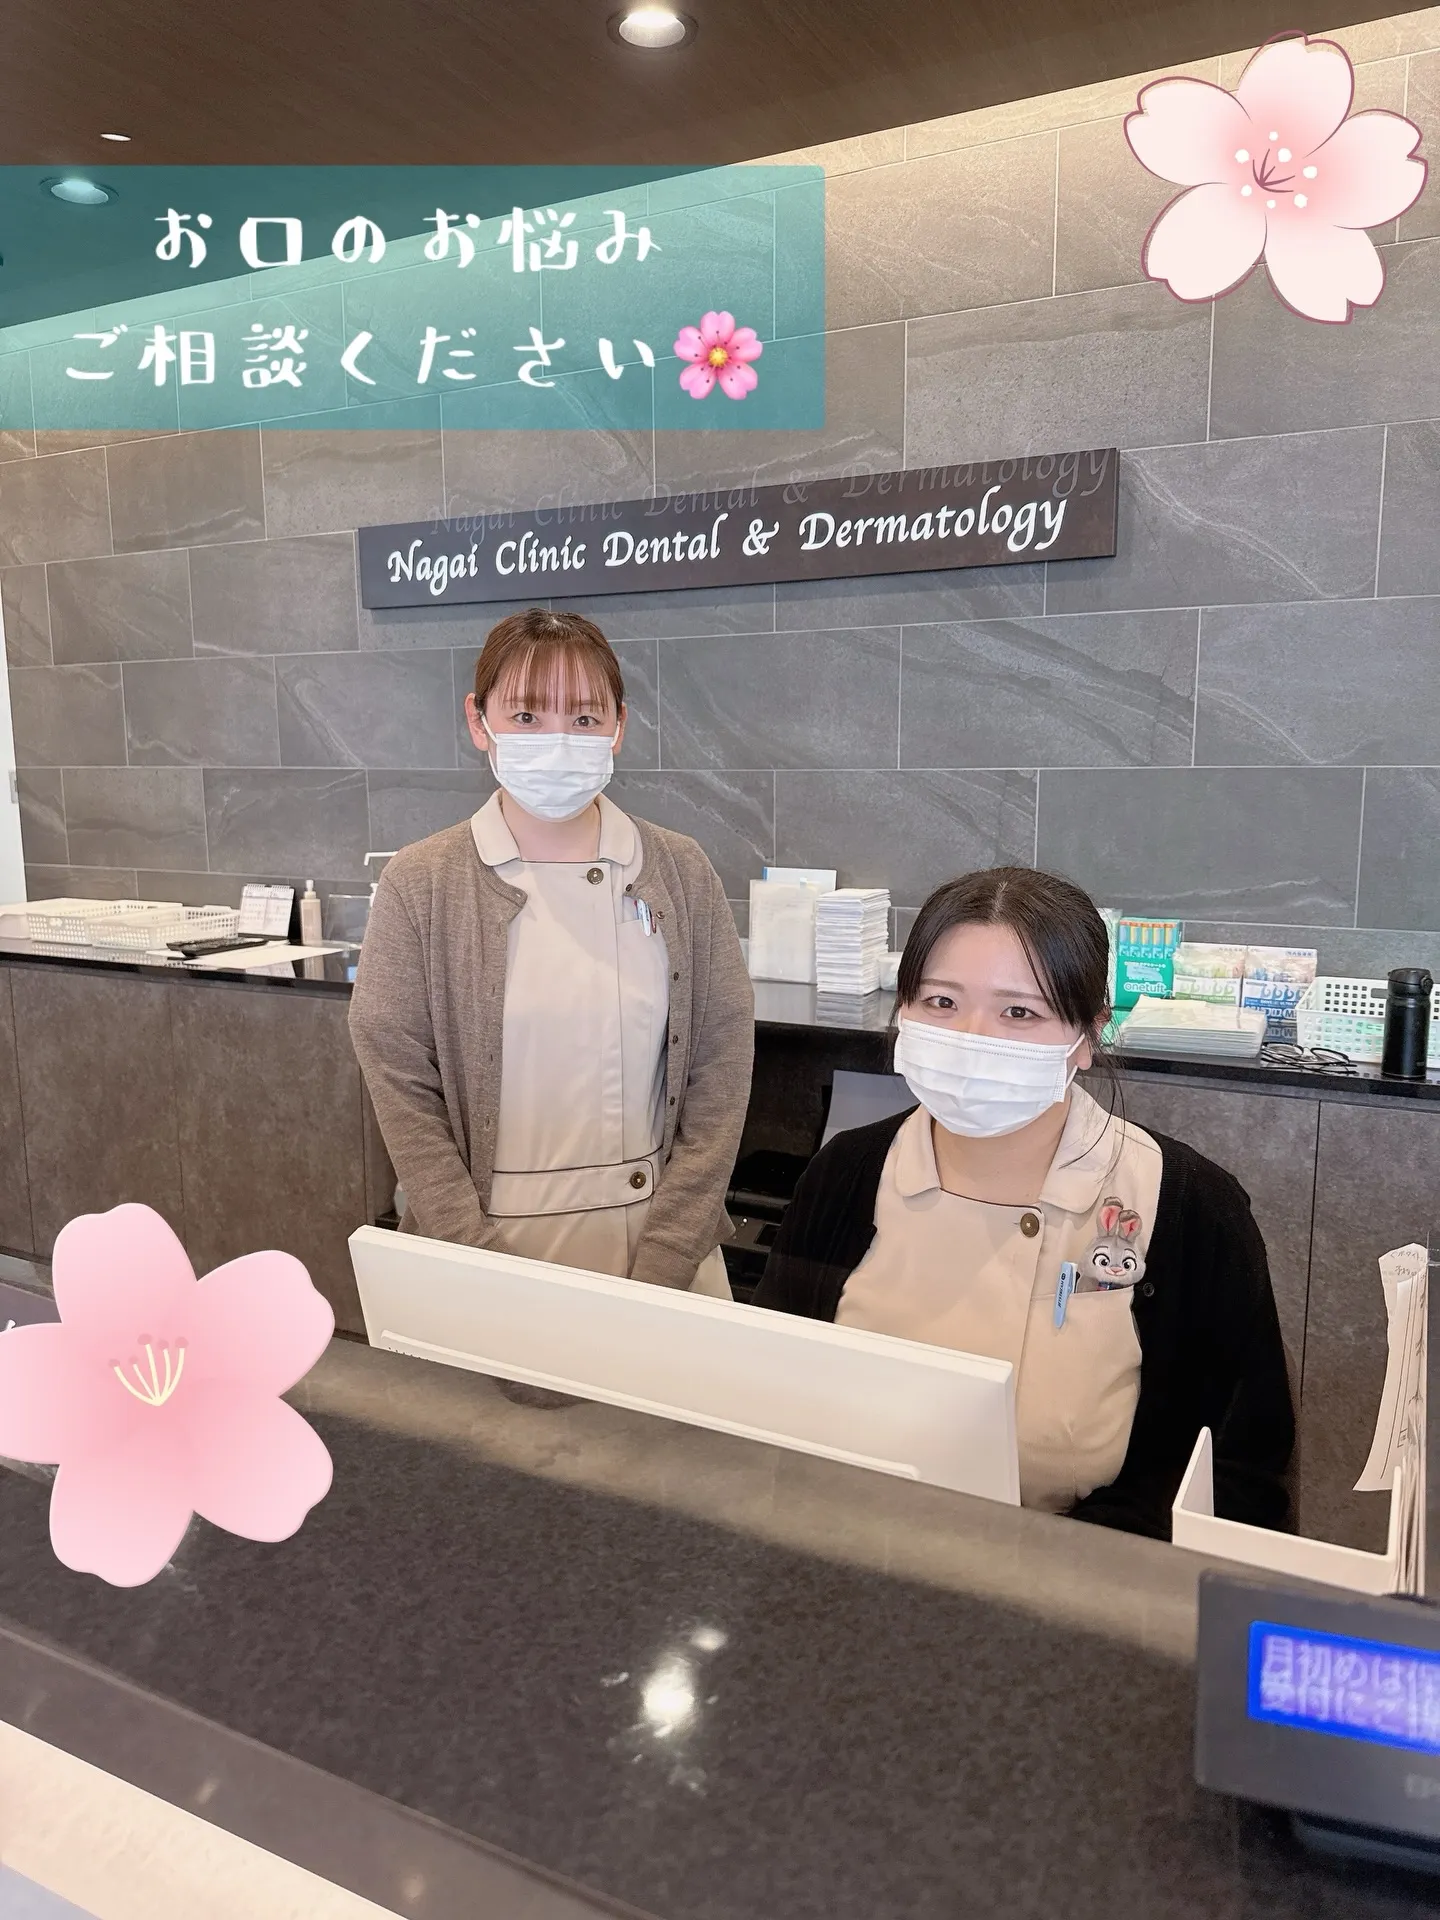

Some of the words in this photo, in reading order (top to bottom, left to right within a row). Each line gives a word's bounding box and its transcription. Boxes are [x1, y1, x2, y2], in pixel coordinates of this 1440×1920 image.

[387, 538, 479, 597] Nagai
[495, 530, 587, 576] Clinic
[602, 512, 729, 568] Dental
[742, 518, 780, 556] &
[799, 485, 1067, 552] Dermatology
[1124, 982, 1165, 993] onetuft
